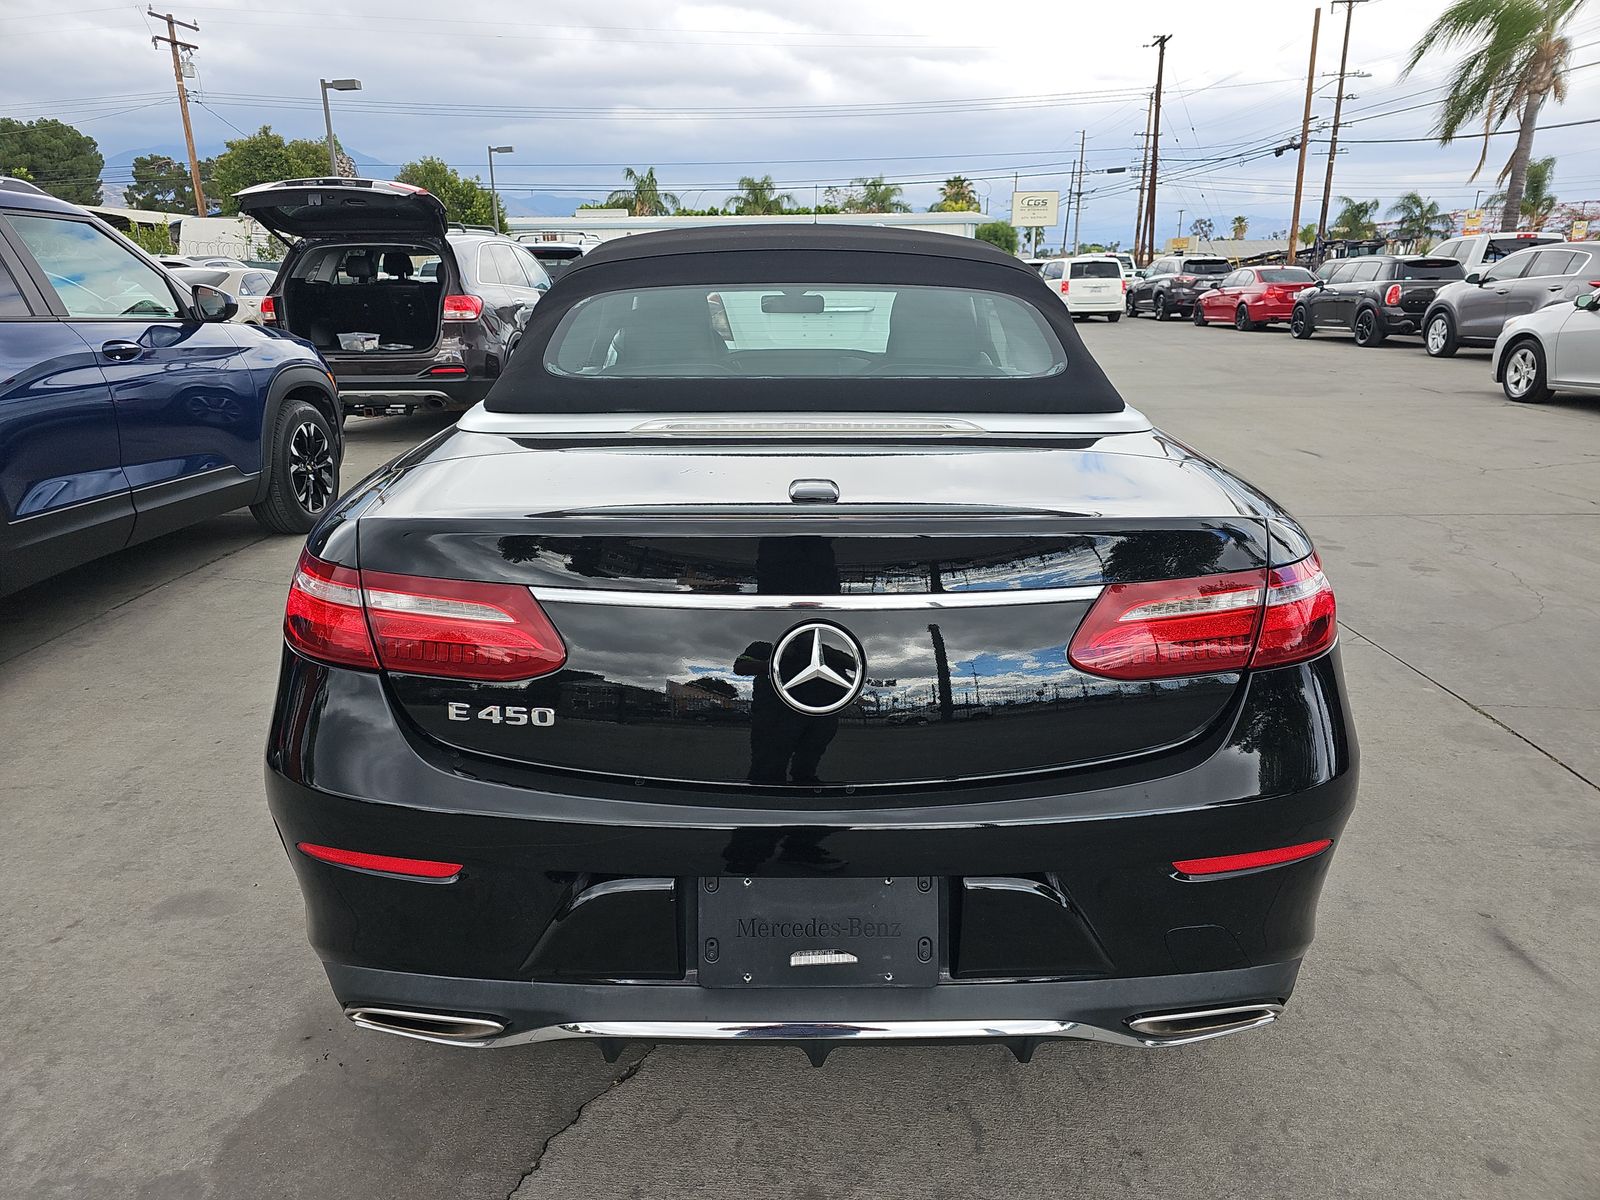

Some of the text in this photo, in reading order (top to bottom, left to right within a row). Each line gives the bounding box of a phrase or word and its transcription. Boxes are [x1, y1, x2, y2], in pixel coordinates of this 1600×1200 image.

[448, 702, 555, 727] E 450
[735, 917, 902, 939] Mercedes-Benz
